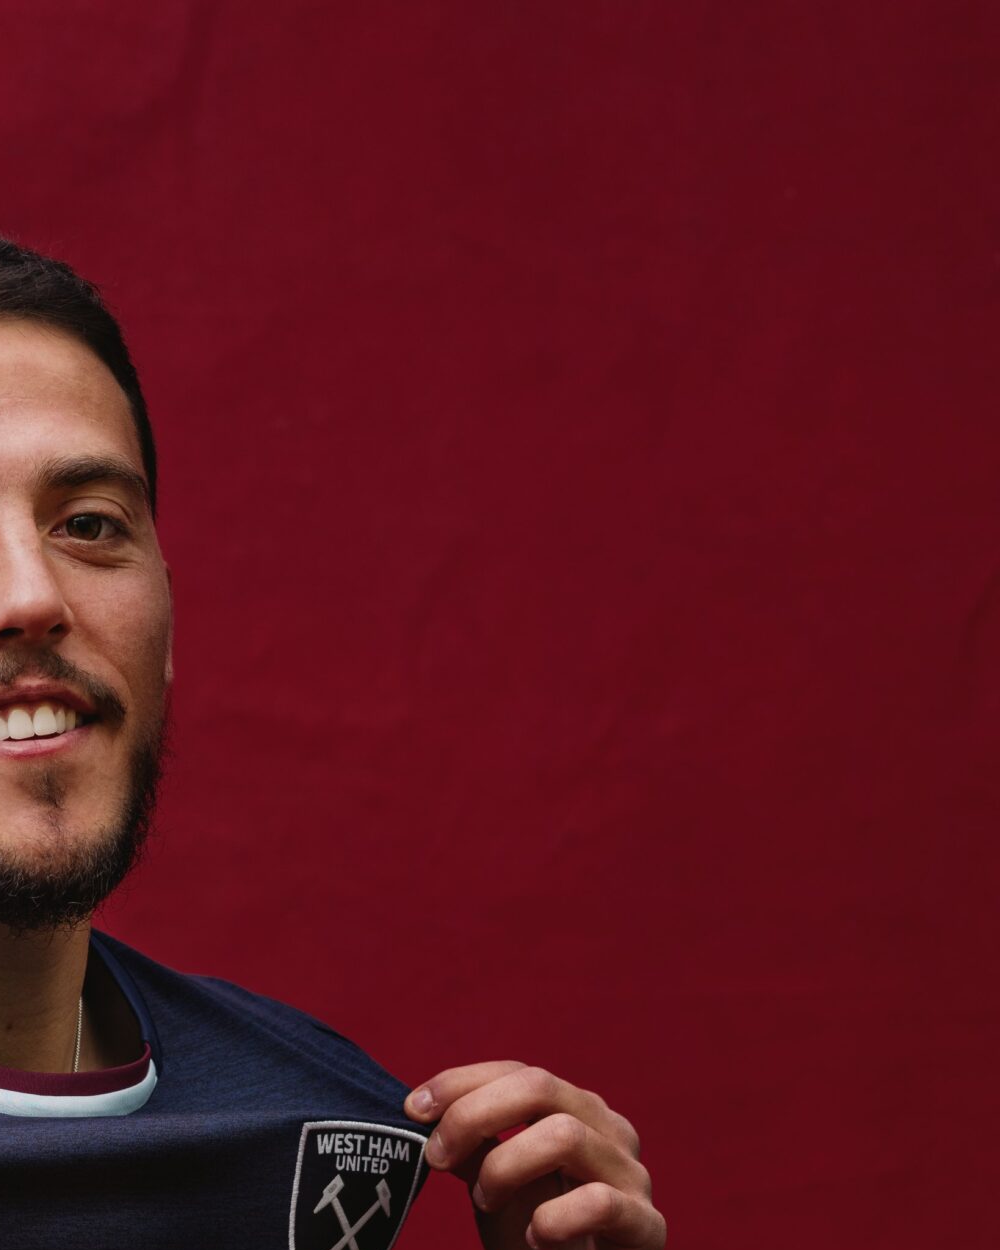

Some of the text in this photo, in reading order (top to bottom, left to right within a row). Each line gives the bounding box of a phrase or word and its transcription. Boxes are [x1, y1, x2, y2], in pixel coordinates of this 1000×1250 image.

[317, 1133, 410, 1162] WEST HAM
[336, 1155, 390, 1174] UNITED
